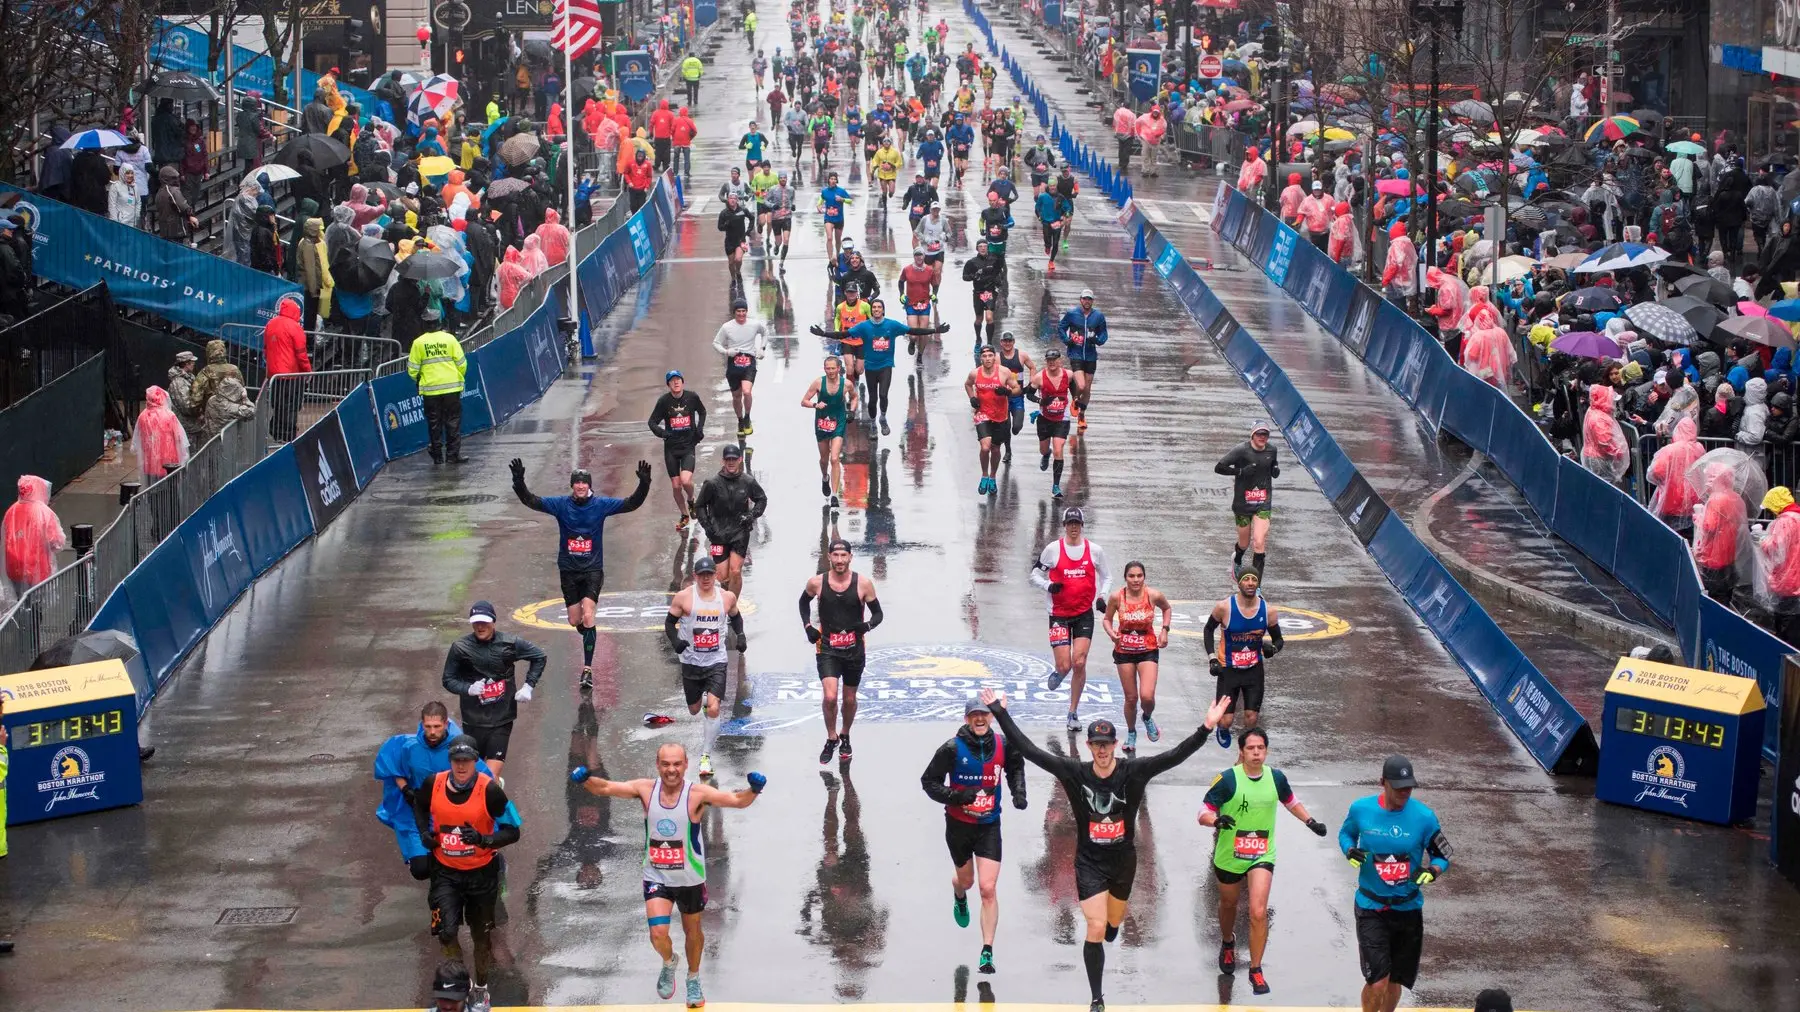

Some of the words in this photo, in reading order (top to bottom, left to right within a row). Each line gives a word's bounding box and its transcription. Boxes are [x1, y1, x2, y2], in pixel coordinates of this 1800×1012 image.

[94, 255, 177, 289] PATRIOTS'
[183, 285, 216, 304] DAY
[256, 308, 279, 320] BOSTO
[424, 342, 448, 350] Boston
[425, 348, 449, 358] Police
[397, 400, 412, 413] THE
[672, 415, 690, 425] 3809
[319, 479, 342, 507] adidas
[570, 540, 590, 549] 6318
[695, 635, 718, 644] 3628
[832, 633, 854, 643] 3442
[1122, 634, 1145, 644] 6625
[1718, 646, 1731, 668] THE
[1731, 654, 1758, 681] BOSTON
[16, 683, 35, 692] 2018
[36, 678, 69, 689] BOSTON
[1635, 677, 1688, 692] MARATHON
[1638, 671, 1657, 679] 2018
[1658, 674, 1690, 685] BOSTON
[18, 684, 73, 699] MARATHON
[910, 679, 1111, 693] BOSTON
[1525, 680, 1536, 698] THE
[1530, 688, 1552, 715] BOSTON
[1513, 696, 1542, 731] MARATHON
[30, 710, 121, 746] 3:13:43
[1632, 710, 1725, 747] 3:13:43
[37, 779, 65, 791] BOSTON
[66, 773, 104, 786] MARATHON
[1631, 771, 1658, 783] BOSTON
[1659, 777, 1697, 790] MARATHON
[44, 790, 68, 812] John
[66, 785, 100, 800] Hancock
[1634, 784, 1658, 803] John
[1656, 787, 1689, 809] Hancock
[1092, 822, 1122, 834] 4597
[1237, 838, 1266, 850] 3506
[653, 848, 681, 860] 2133
[1375, 862, 1406, 877] 5479
